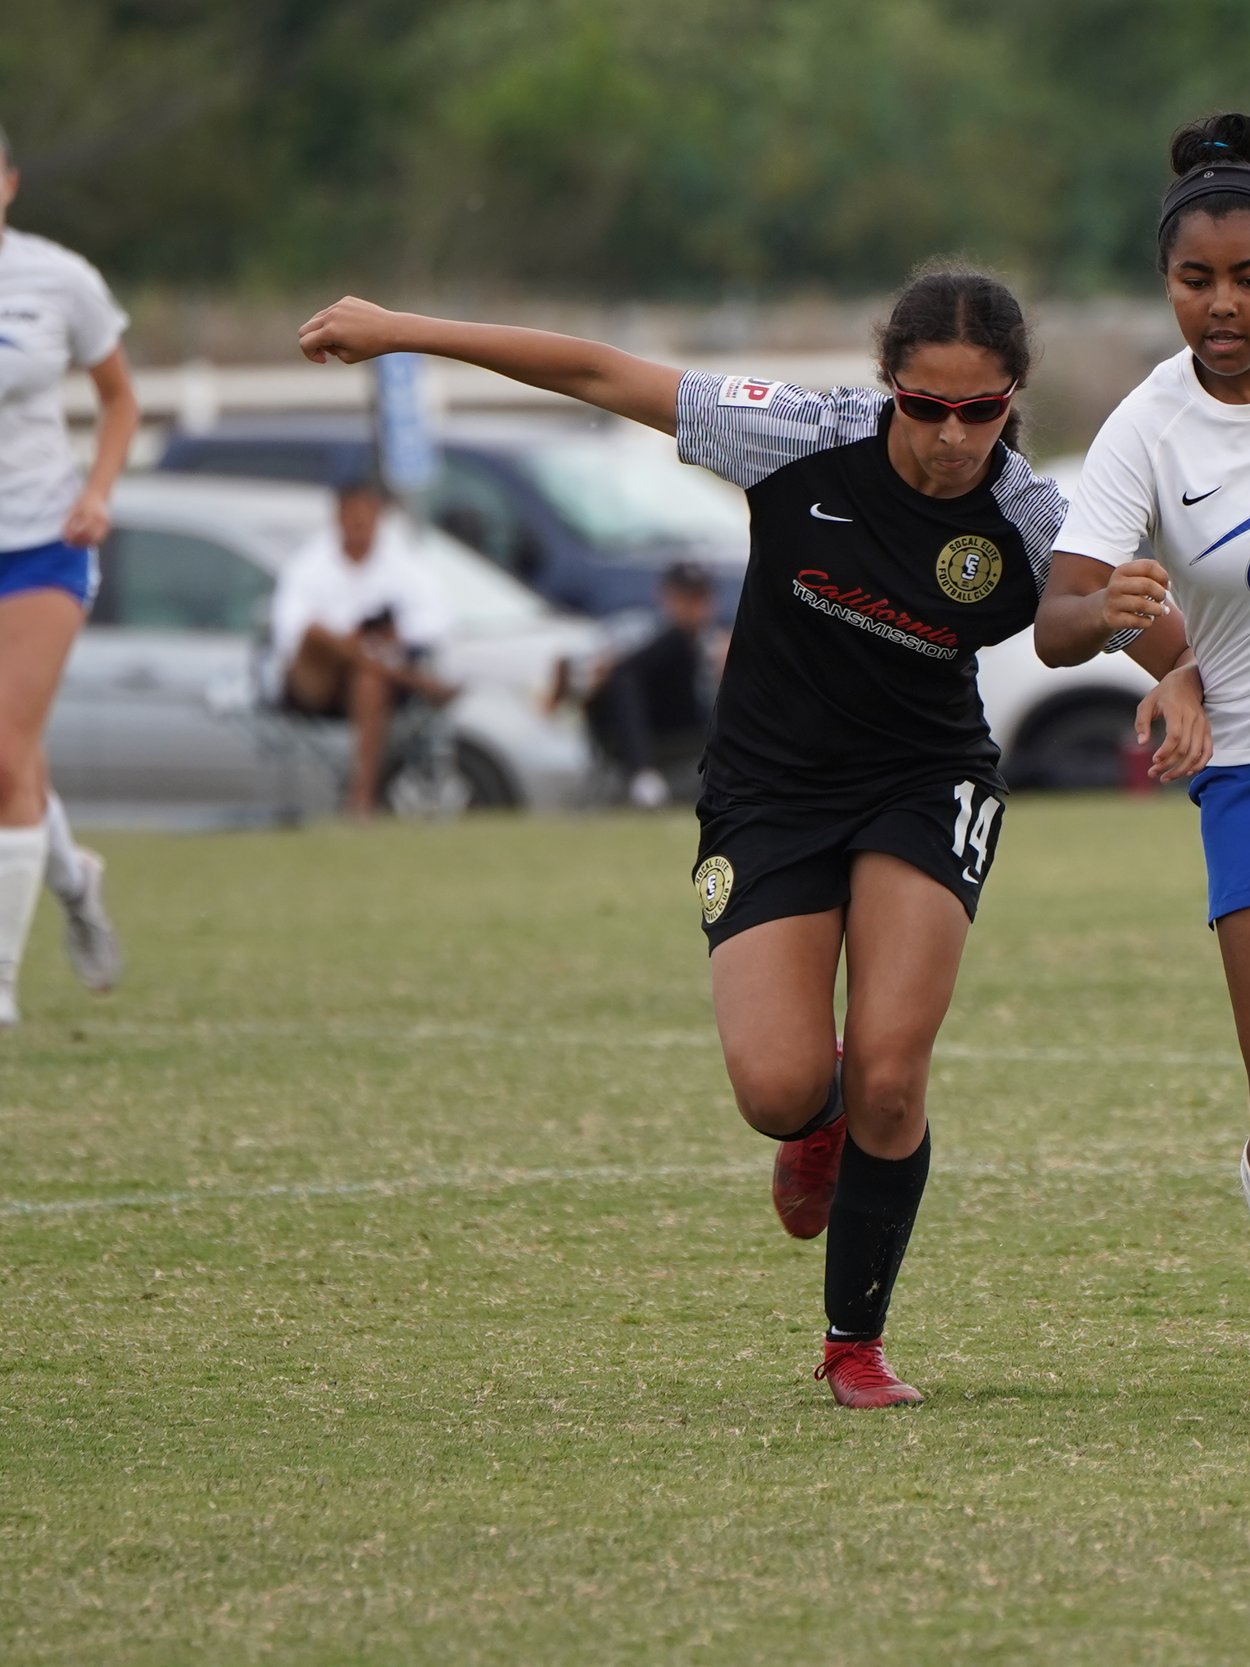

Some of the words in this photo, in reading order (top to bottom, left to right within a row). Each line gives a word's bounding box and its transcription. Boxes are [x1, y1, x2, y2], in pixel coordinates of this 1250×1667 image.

[938, 568, 973, 601] FOOTBALL
[973, 580, 994, 600] CLUB
[949, 538, 978, 552] SOCAL
[980, 541, 999, 562] ELITE
[792, 578, 958, 660] TRANSMISSION
[798, 569, 959, 647] California
[951, 780, 1001, 876] 14
